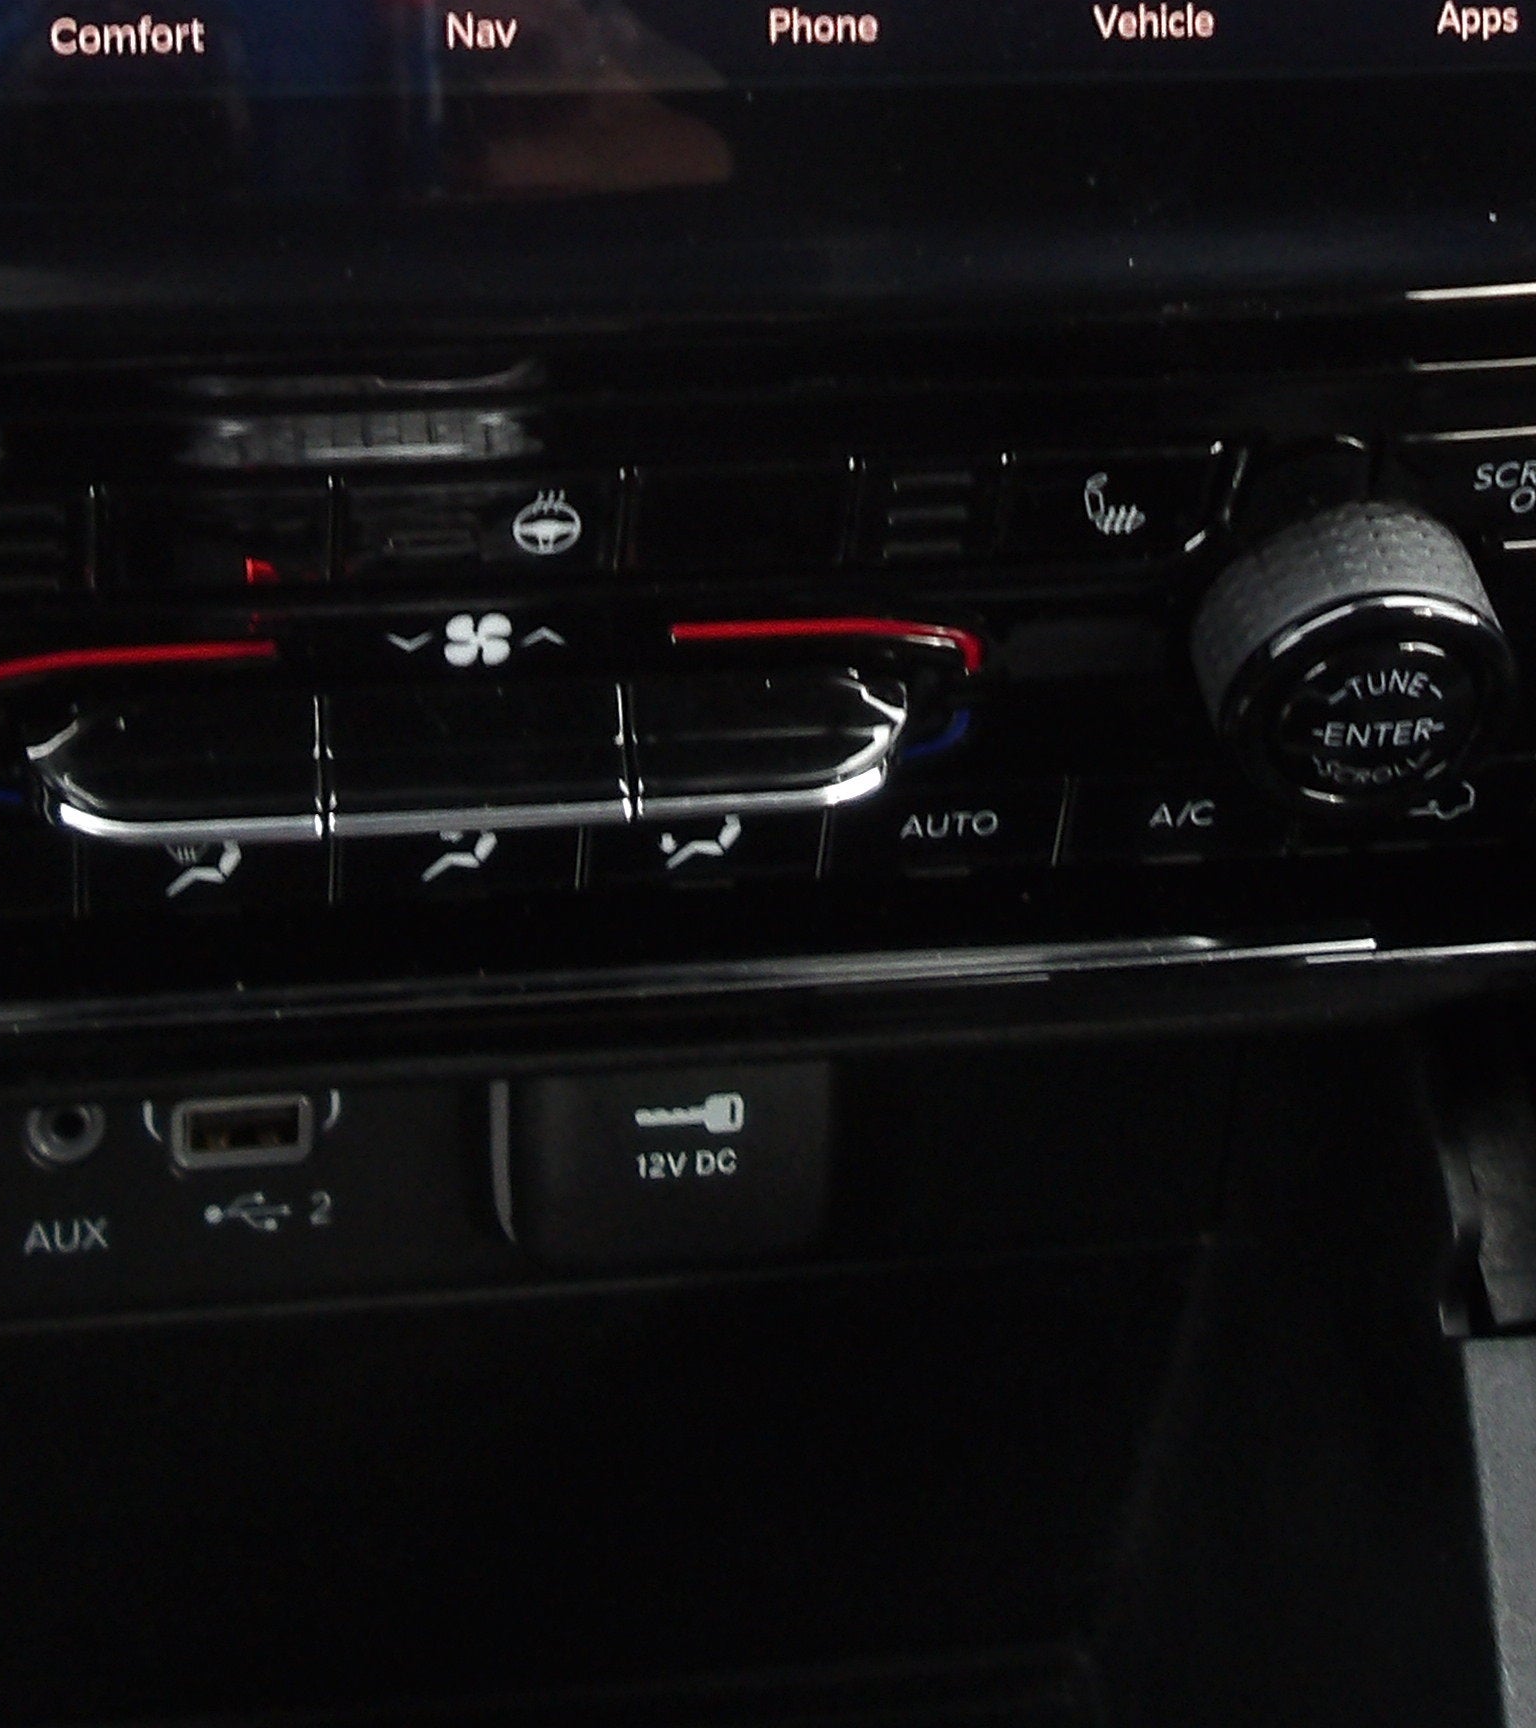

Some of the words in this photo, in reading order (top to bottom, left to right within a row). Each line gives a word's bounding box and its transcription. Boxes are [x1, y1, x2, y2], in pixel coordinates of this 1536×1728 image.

[50, 15, 205, 56] Comfort
[446, 11, 519, 50] Nav
[768, 7, 879, 44] Phone
[1092, 2, 1216, 40] Vehicle
[1436, 0, 1519, 41] Apps
[1345, 668, 1430, 700] TUNE
[1323, 716, 1434, 748] ENTER
[900, 810, 999, 840] AUTO
[1149, 799, 1216, 829] A/C
[636, 1151, 688, 1179] 12V
[695, 1146, 738, 1177] DC
[309, 1190, 332, 1226] 2
[23, 1217, 110, 1256] AUX
